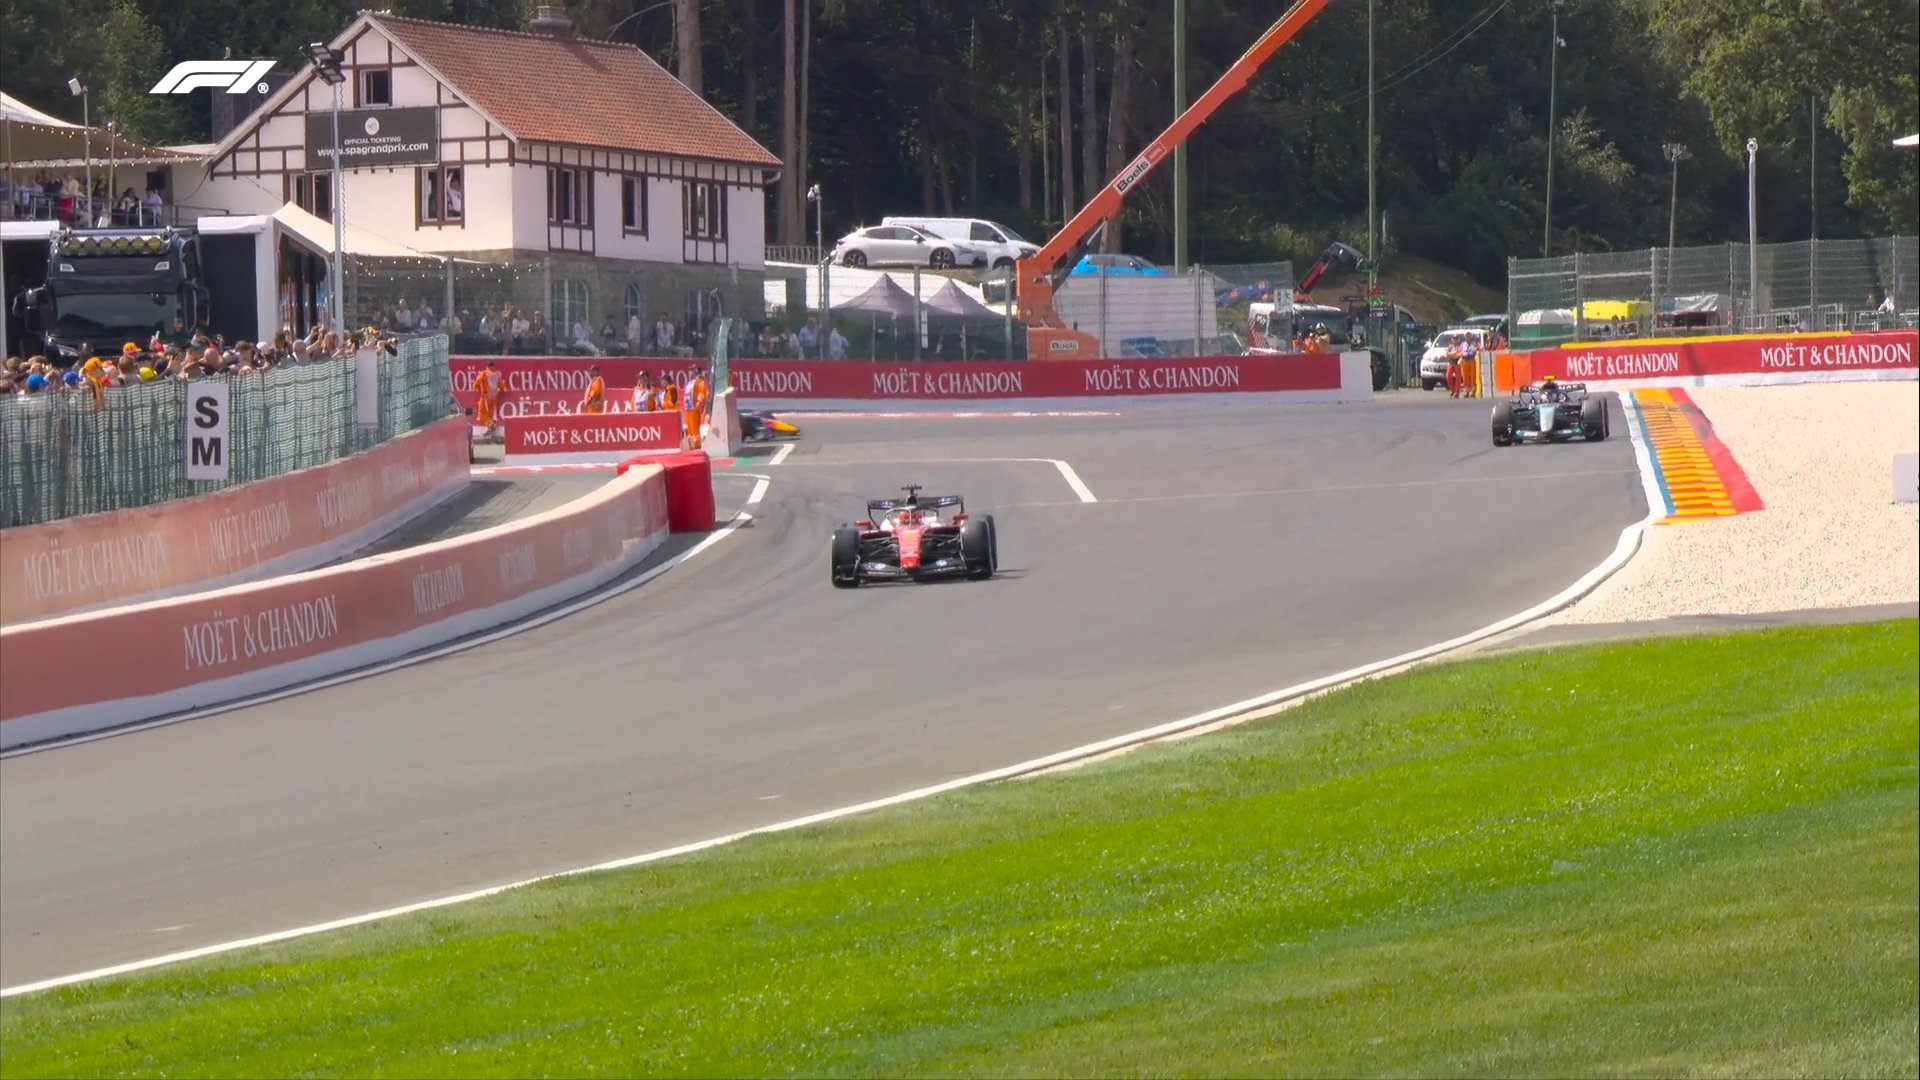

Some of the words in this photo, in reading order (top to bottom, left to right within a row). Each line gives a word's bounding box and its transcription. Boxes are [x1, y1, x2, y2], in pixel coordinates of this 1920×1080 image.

[1116, 161, 1149, 192] Boels
[1567, 352, 1604, 377] MOËT
[1606, 356, 1615, 376] &
[1616, 353, 1679, 374] CHANDON
[1761, 342, 1807, 367] MOËT
[1810, 345, 1821, 365] &
[1824, 343, 1911, 365] CHANDON
[873, 368, 920, 393] MOËT
[924, 373, 936, 393] &
[938, 372, 1022, 393] CHANDON
[1085, 365, 1133, 390] MOËT
[1138, 368, 1150, 389] &
[1153, 366, 1239, 389] CHANDON
[523, 427, 568, 445] MOËT
[571, 431, 582, 443] &
[584, 426, 662, 443] CHANDON
[183, 610, 238, 670] MOËT
[243, 614, 258, 657] &
[257, 595, 338, 653] CHANDON
